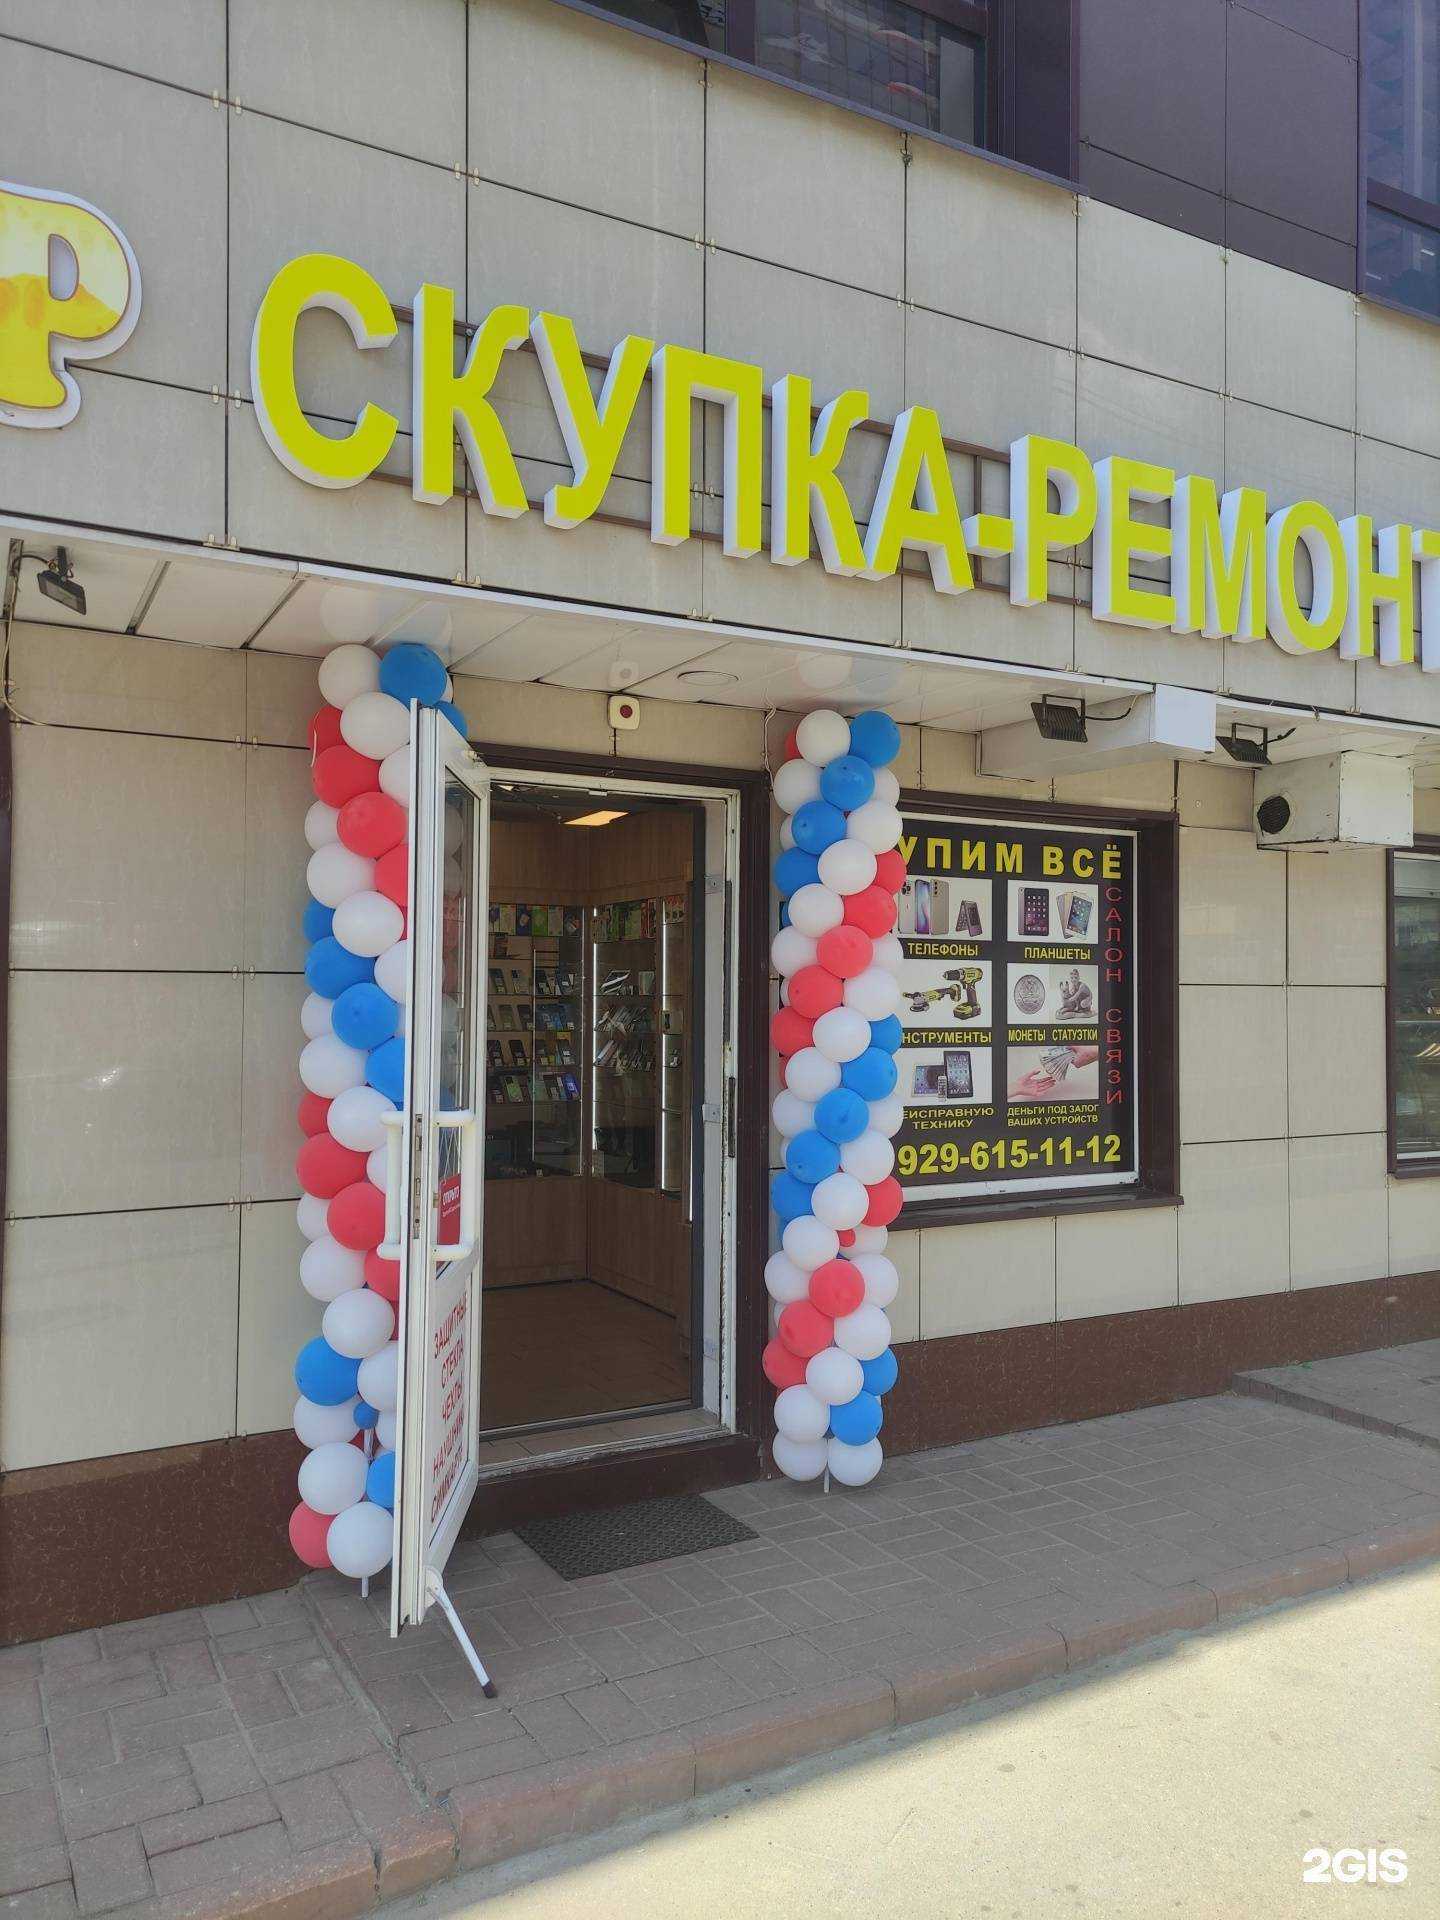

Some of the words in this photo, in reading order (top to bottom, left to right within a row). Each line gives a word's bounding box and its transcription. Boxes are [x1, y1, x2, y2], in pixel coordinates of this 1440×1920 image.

[897, 835, 1024, 874] УПИМ
[1042, 844, 1123, 880] ВСЁ
[1105, 887, 1123, 984] САЛОН
[907, 942, 979, 957] ТЕЛЕФОНЫ
[1024, 946, 1091, 961] ПЛАНШЕТЫ
[902, 1031, 993, 1044] НСТРУМЕНТЫ
[1008, 1029, 1046, 1042] МОНЕТЫ
[1052, 1028, 1098, 1041] СТАТУЭТКИ
[1105, 1008, 1123, 1105] СВЯЗИ
[903, 1107, 994, 1119] ЕИСПРАВНУЮ
[1007, 1106, 1045, 1117] ДЕНЬГИ
[1047, 1105, 1068, 1115] ПОД
[1069, 1104, 1099, 1114] ЗАЛОГ
[912, 1119, 974, 1130] ТЕХНИКУ
[1008, 1117, 1042, 1127] ВАШИХ
[1045, 1114, 1099, 1125] УСТРОЙСТВ
[897, 1134, 1121, 1176] 929-615-11-12
